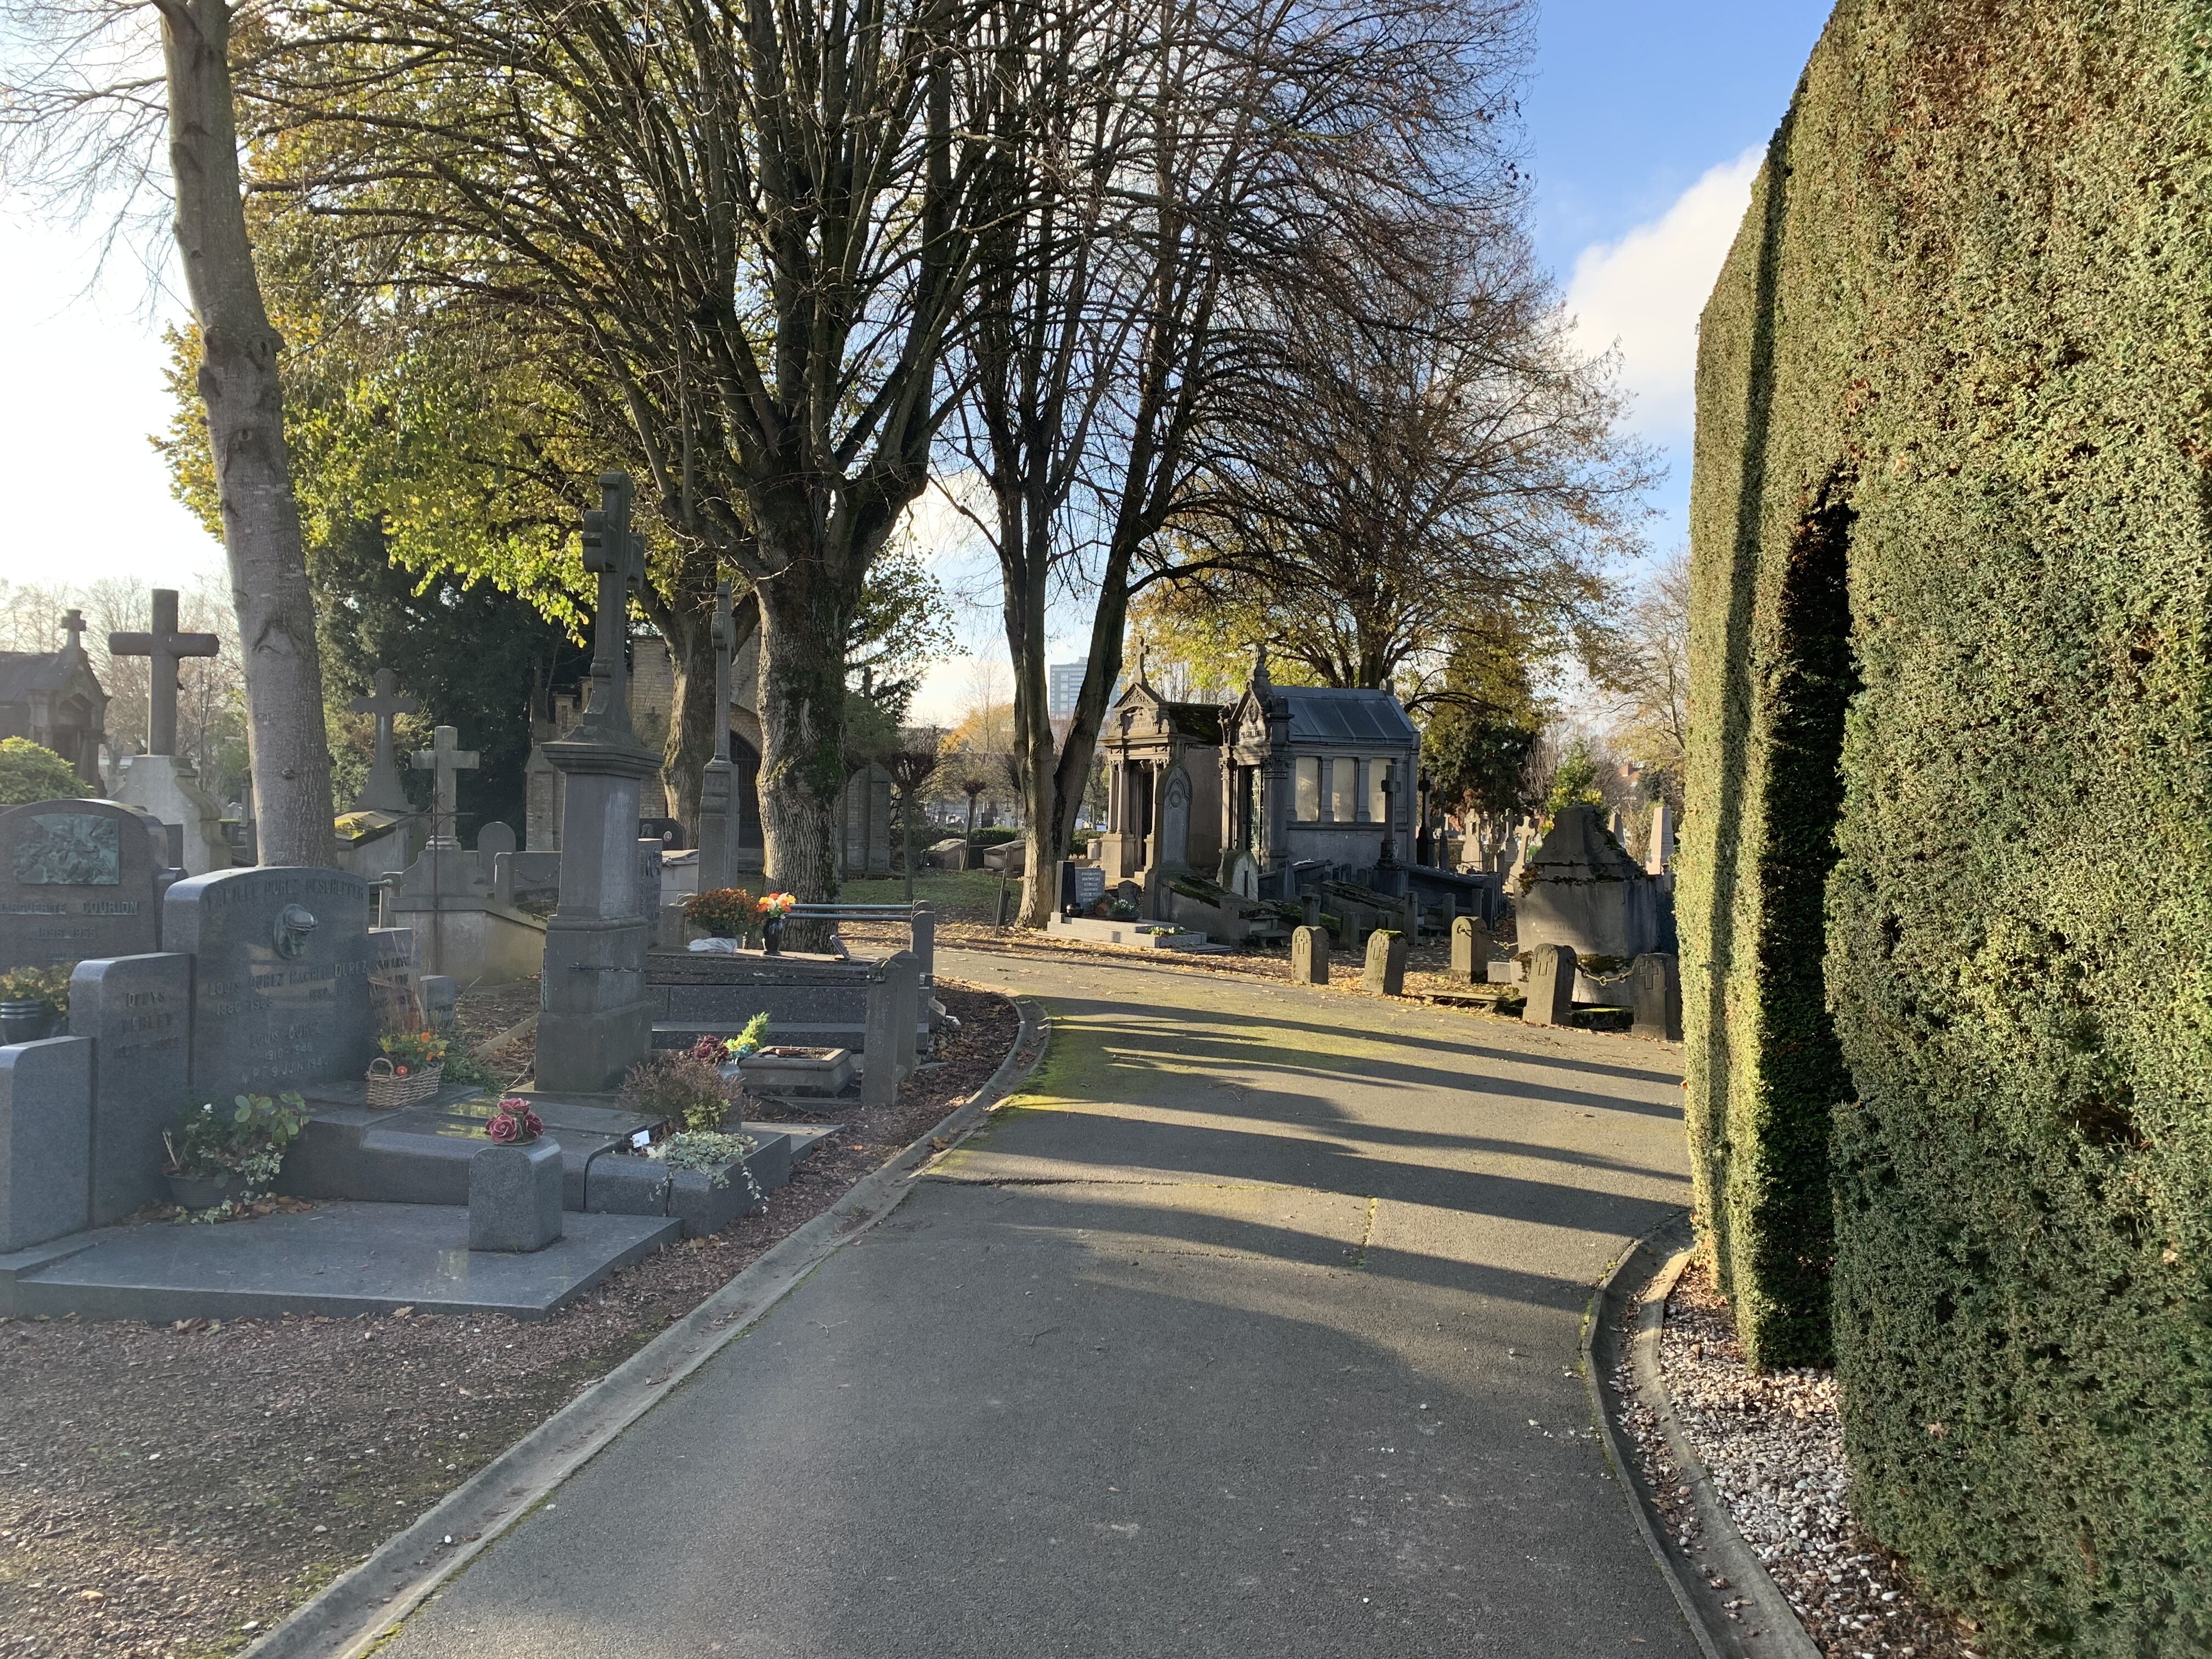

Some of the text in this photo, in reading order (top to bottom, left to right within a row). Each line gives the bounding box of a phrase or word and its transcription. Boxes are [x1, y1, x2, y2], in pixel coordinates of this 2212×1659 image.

[0, 901, 66, 915] ARGUERITE
[334, 960, 368, 978] DUREZ
[281, 1060, 303, 1076] JUIN
